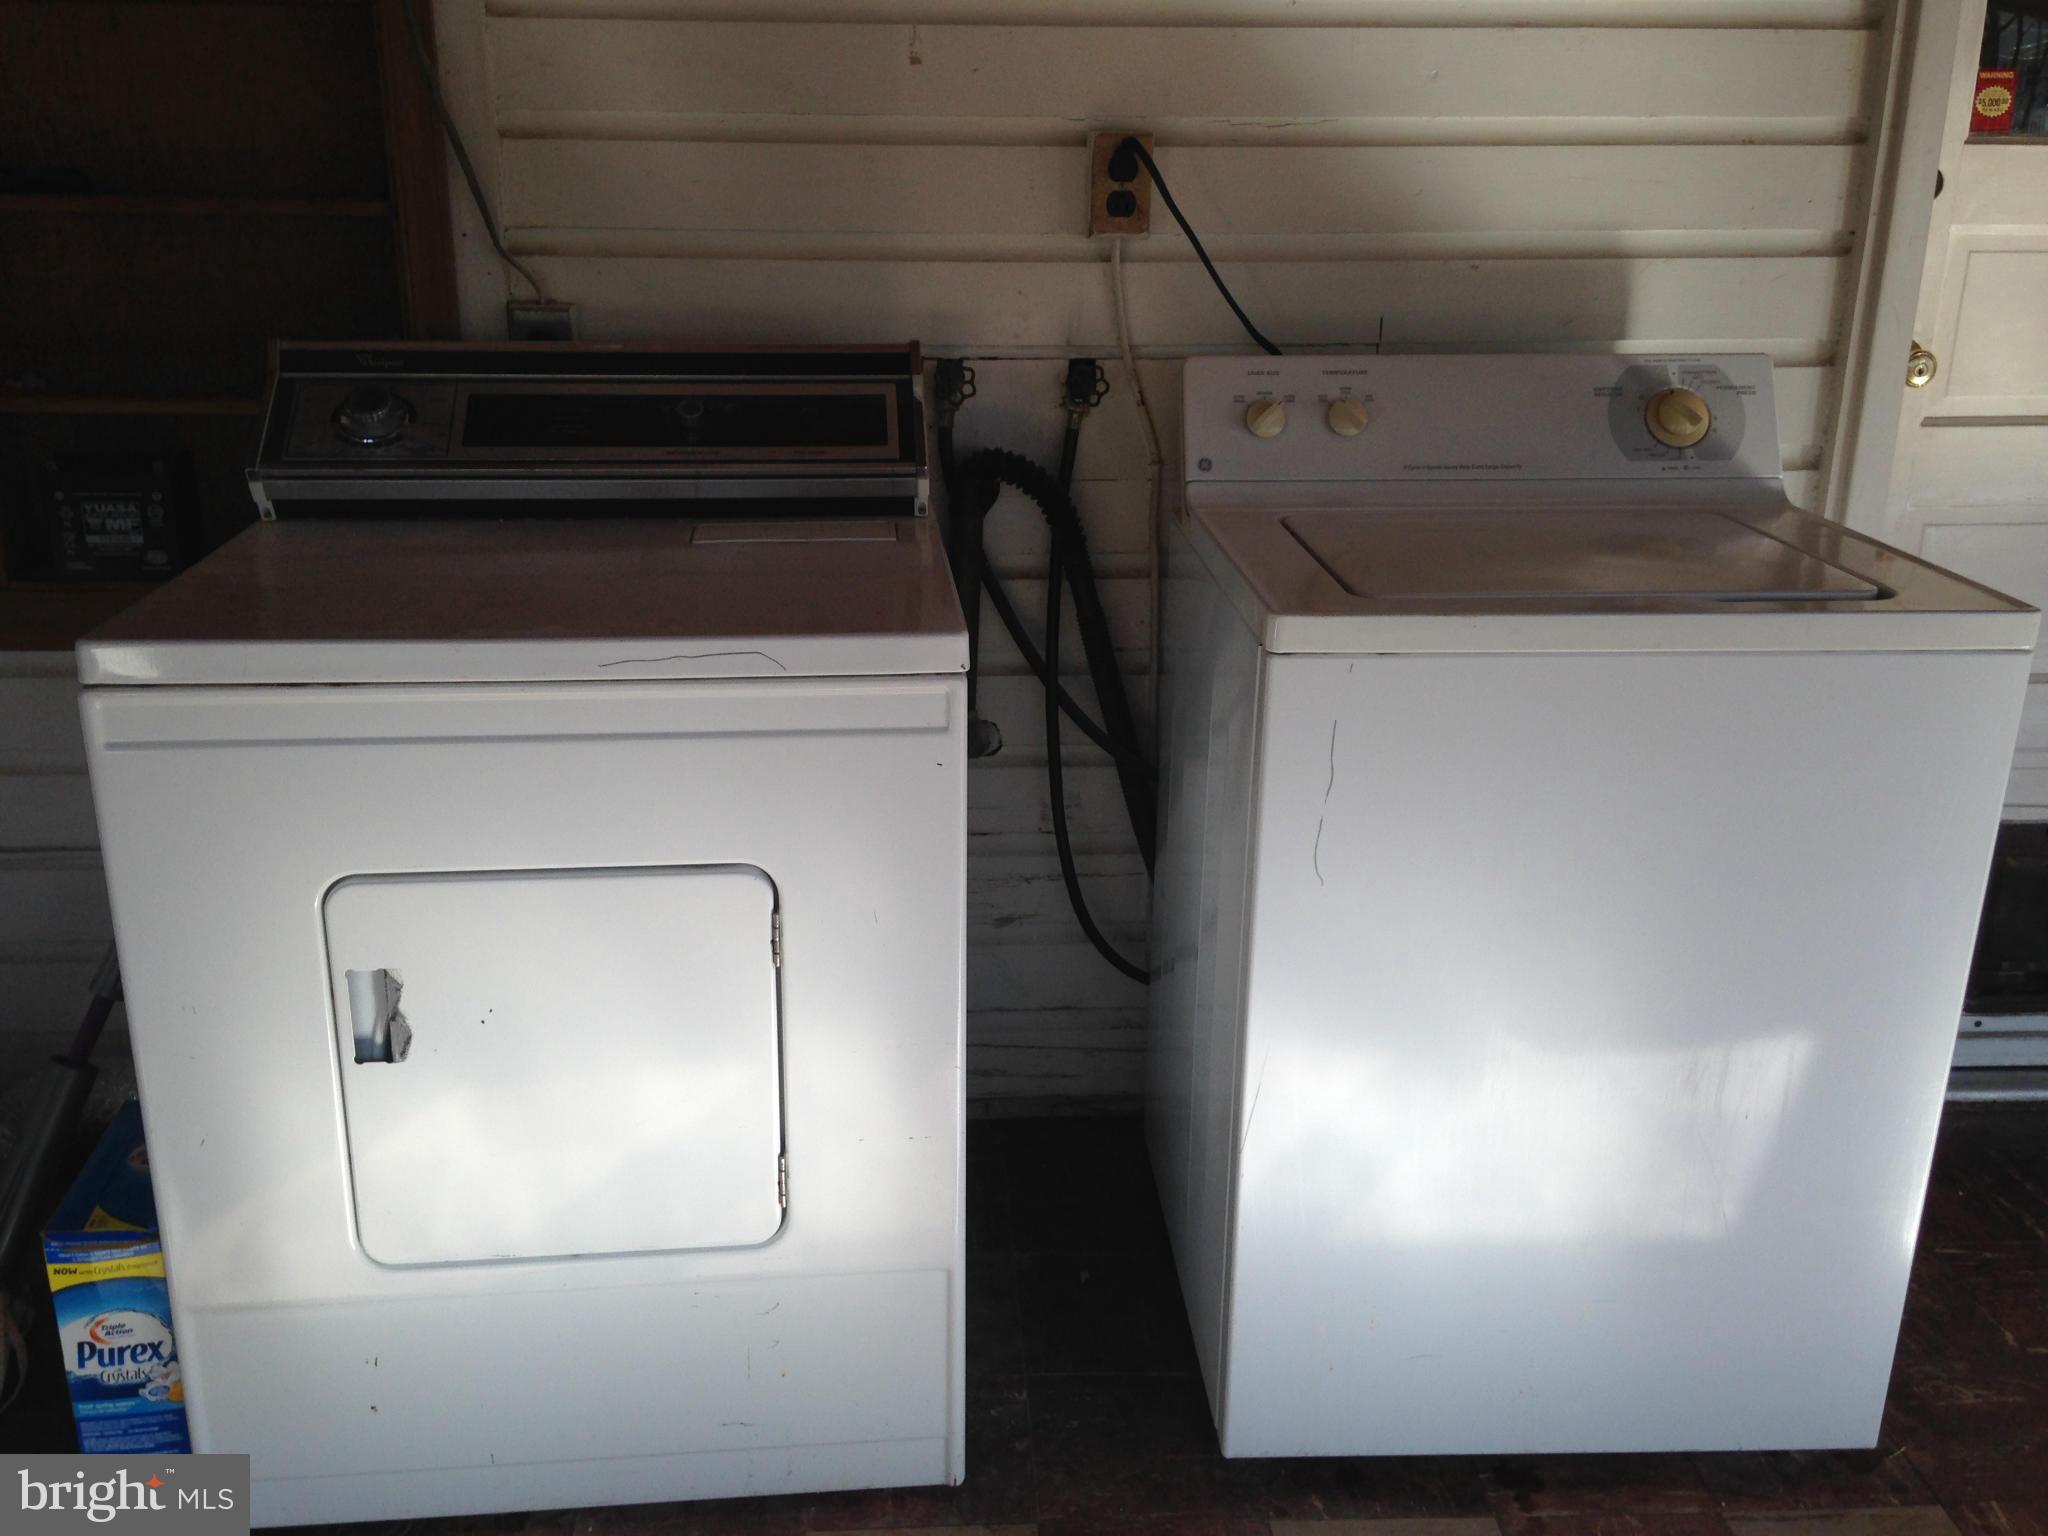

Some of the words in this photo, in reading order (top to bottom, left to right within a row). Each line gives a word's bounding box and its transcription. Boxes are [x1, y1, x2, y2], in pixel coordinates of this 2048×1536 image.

[1979, 71, 2014, 79] WARNING
[83, 503, 137, 512] YUASA
[53, 1267, 78, 1276] NOW
[101, 1322, 126, 1333] Triple
[104, 1328, 135, 1337] Action
[77, 1341, 165, 1369] Purex
[100, 1368, 148, 1383] Crystals
